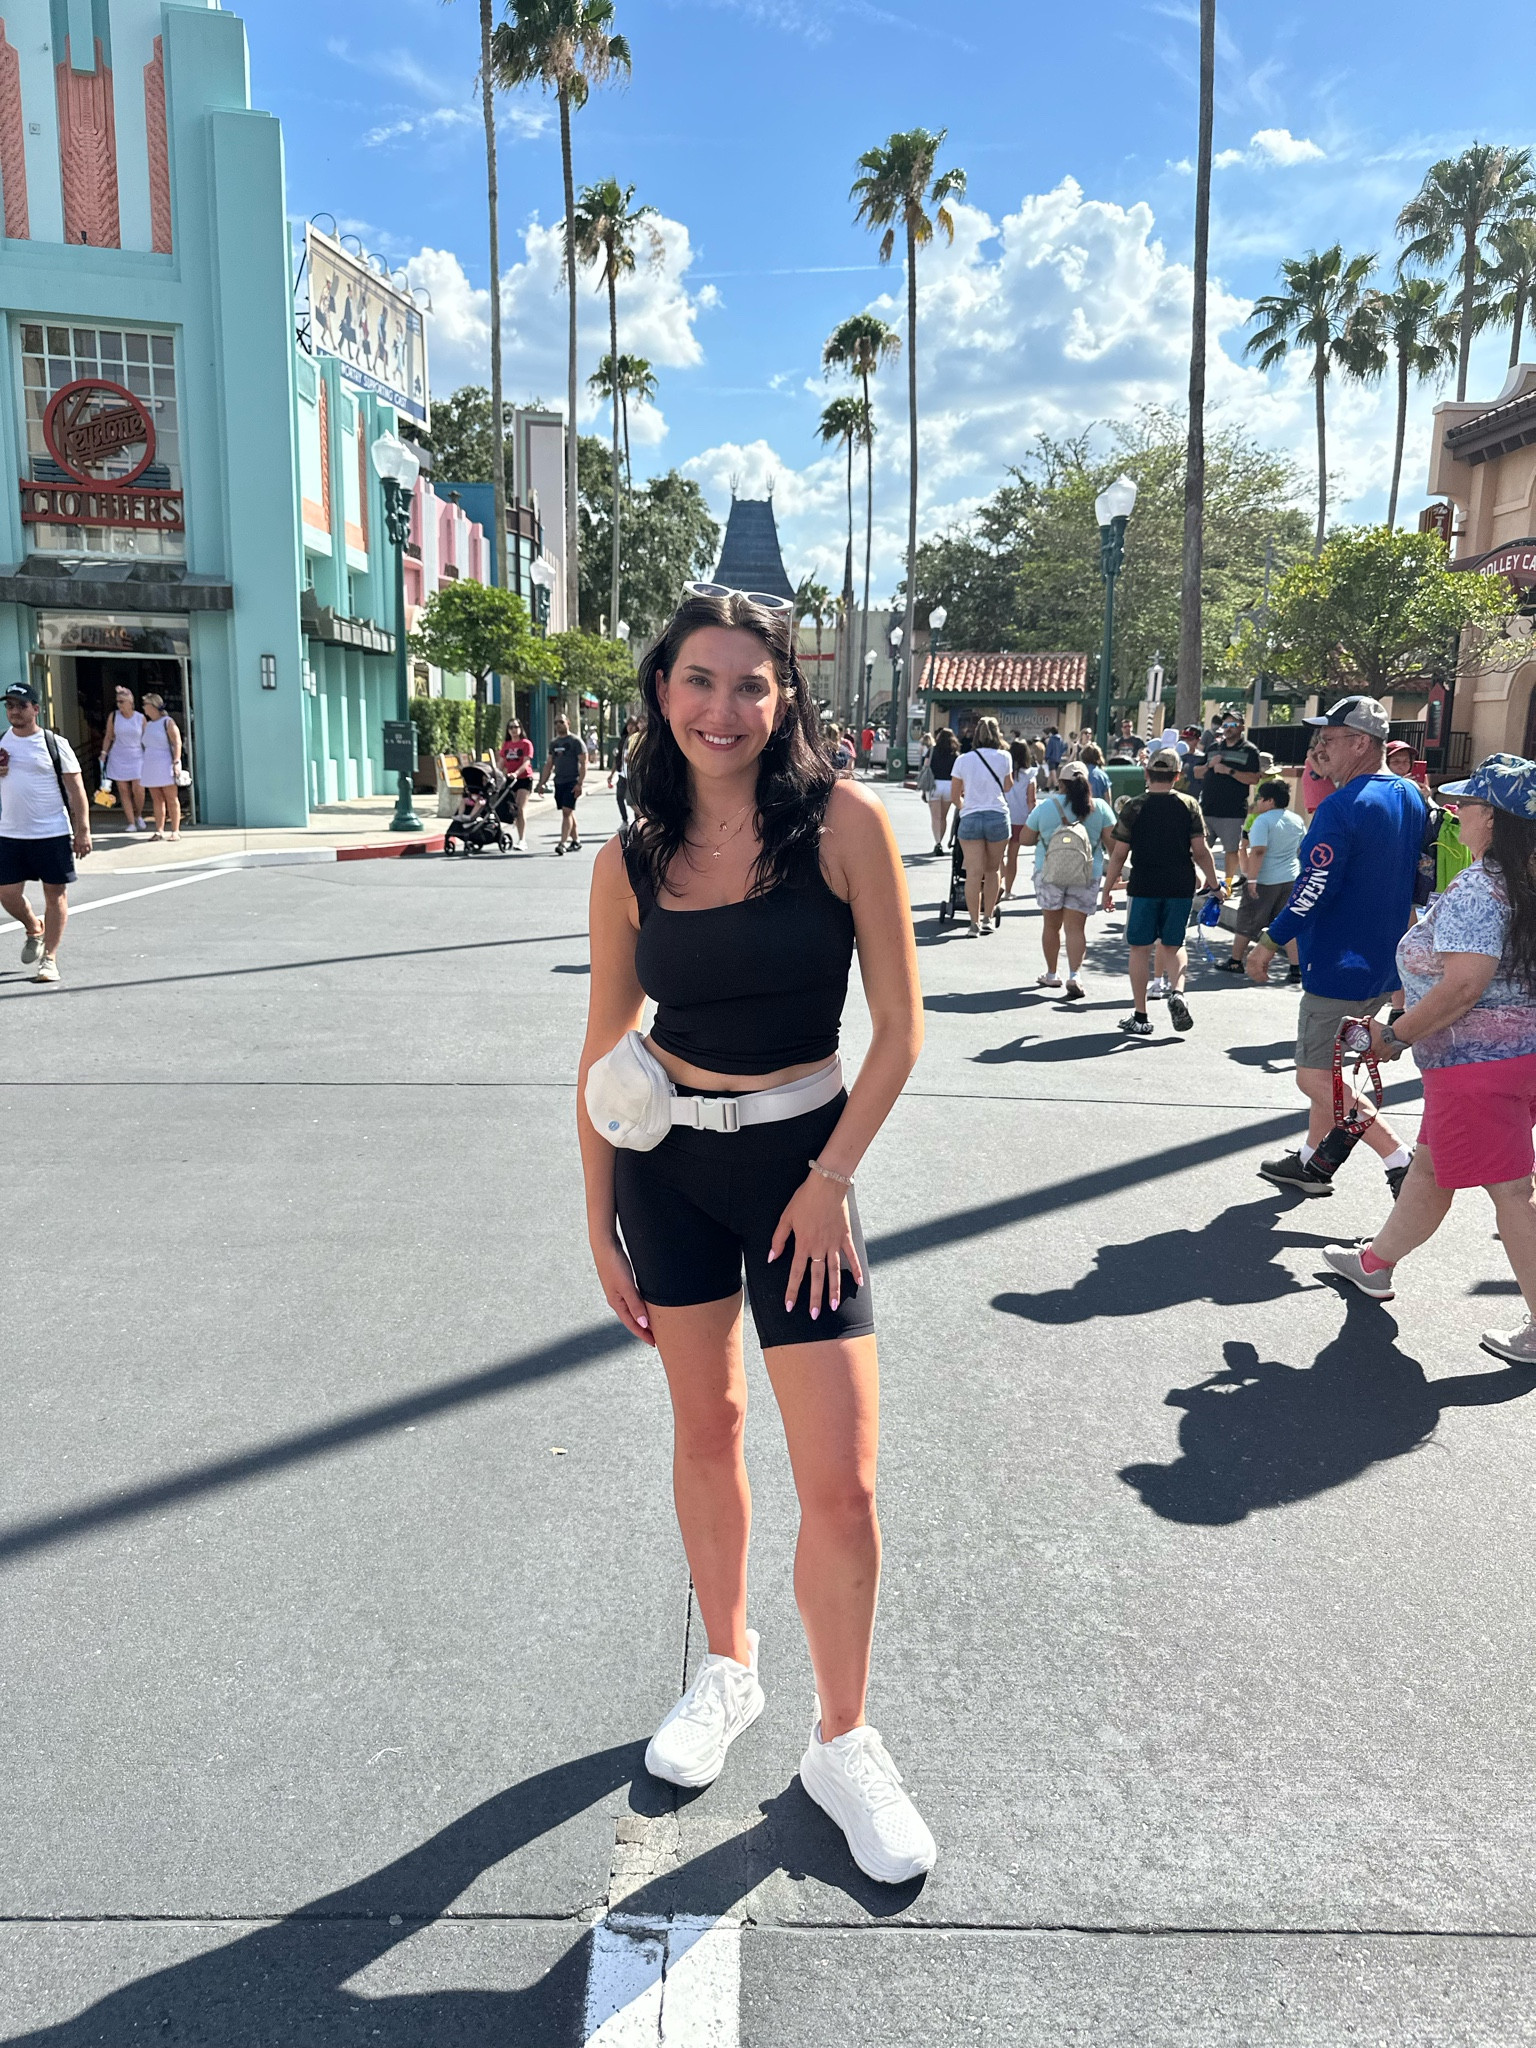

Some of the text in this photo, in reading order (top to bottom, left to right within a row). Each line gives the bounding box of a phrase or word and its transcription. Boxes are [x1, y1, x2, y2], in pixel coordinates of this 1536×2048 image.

[57, 388, 147, 479] Keystone
[26, 489, 180, 523] CLOTHIERS
[1480, 554, 1521, 582] ROLLEY
[998, 712, 1050, 724] HOLLYWOOD
